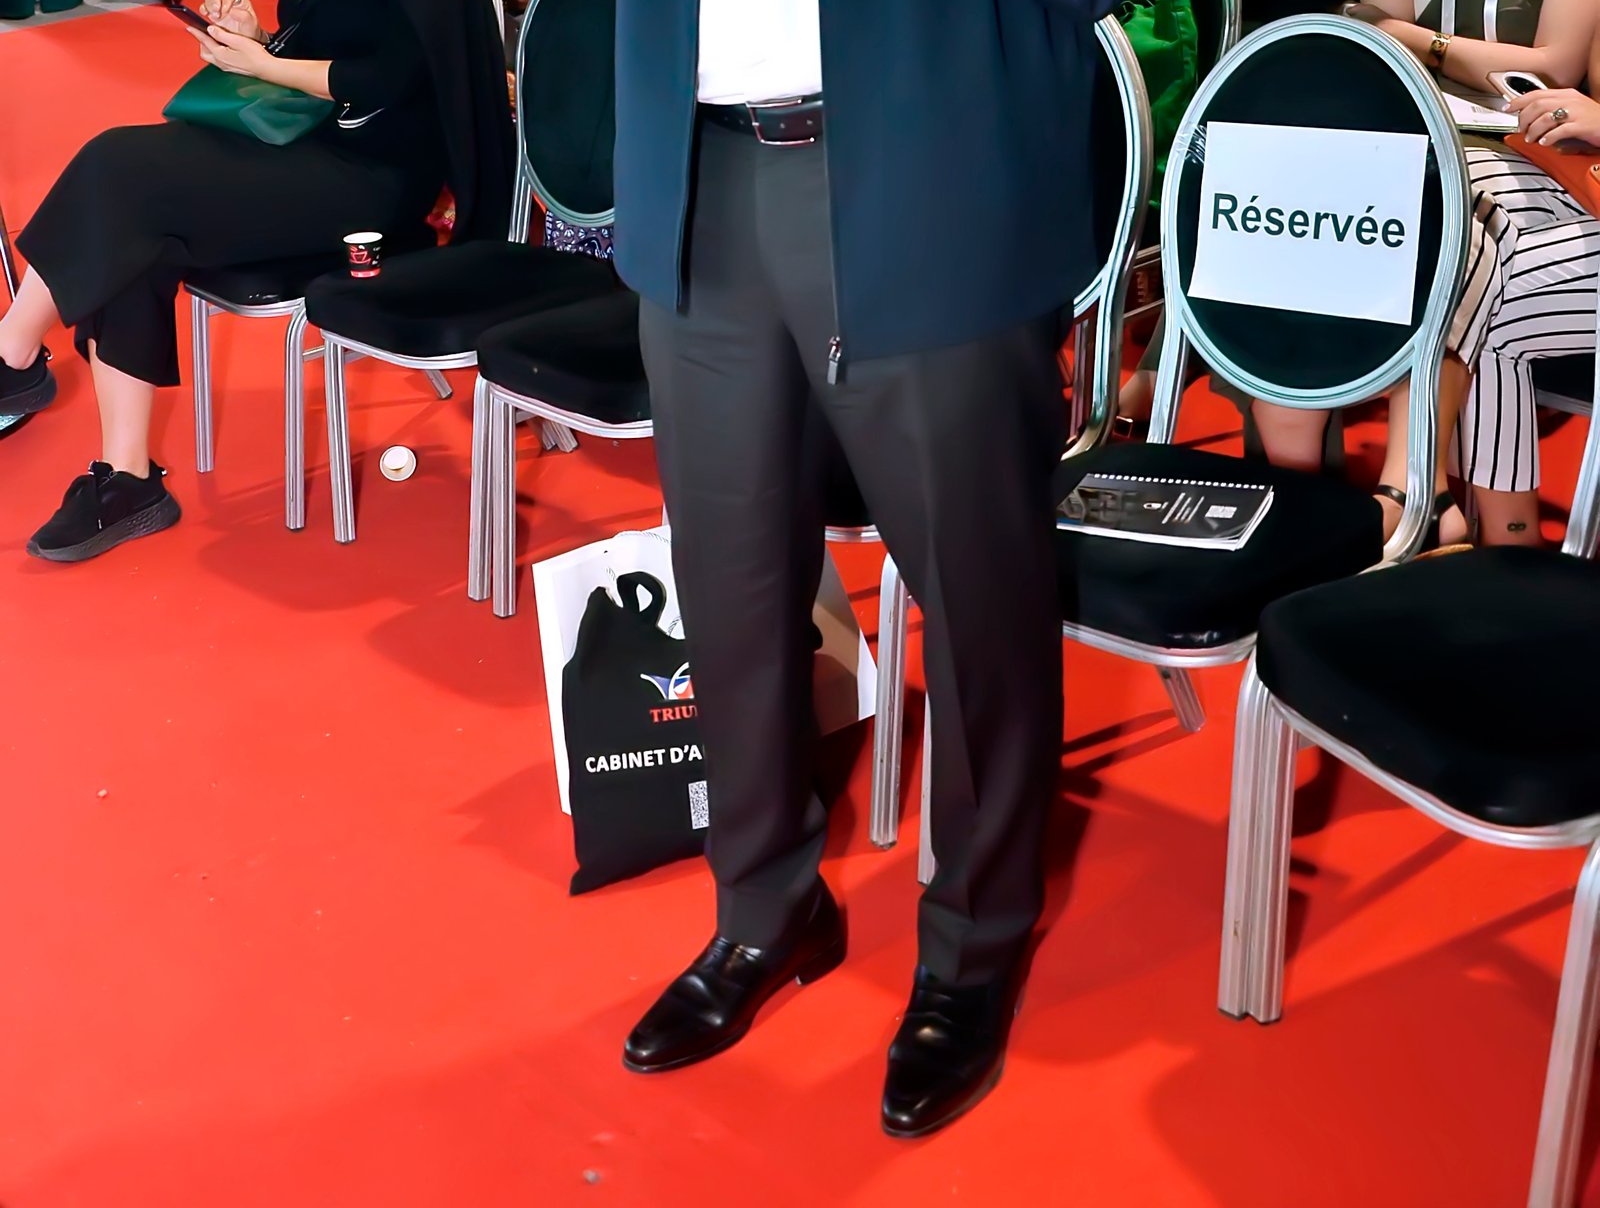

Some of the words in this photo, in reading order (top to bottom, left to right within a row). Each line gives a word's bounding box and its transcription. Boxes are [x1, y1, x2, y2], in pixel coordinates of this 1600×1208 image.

[1212, 193, 1405, 248] Réservée
[585, 748, 665, 773] CABINET
[669, 744, 705, 764] D'A
